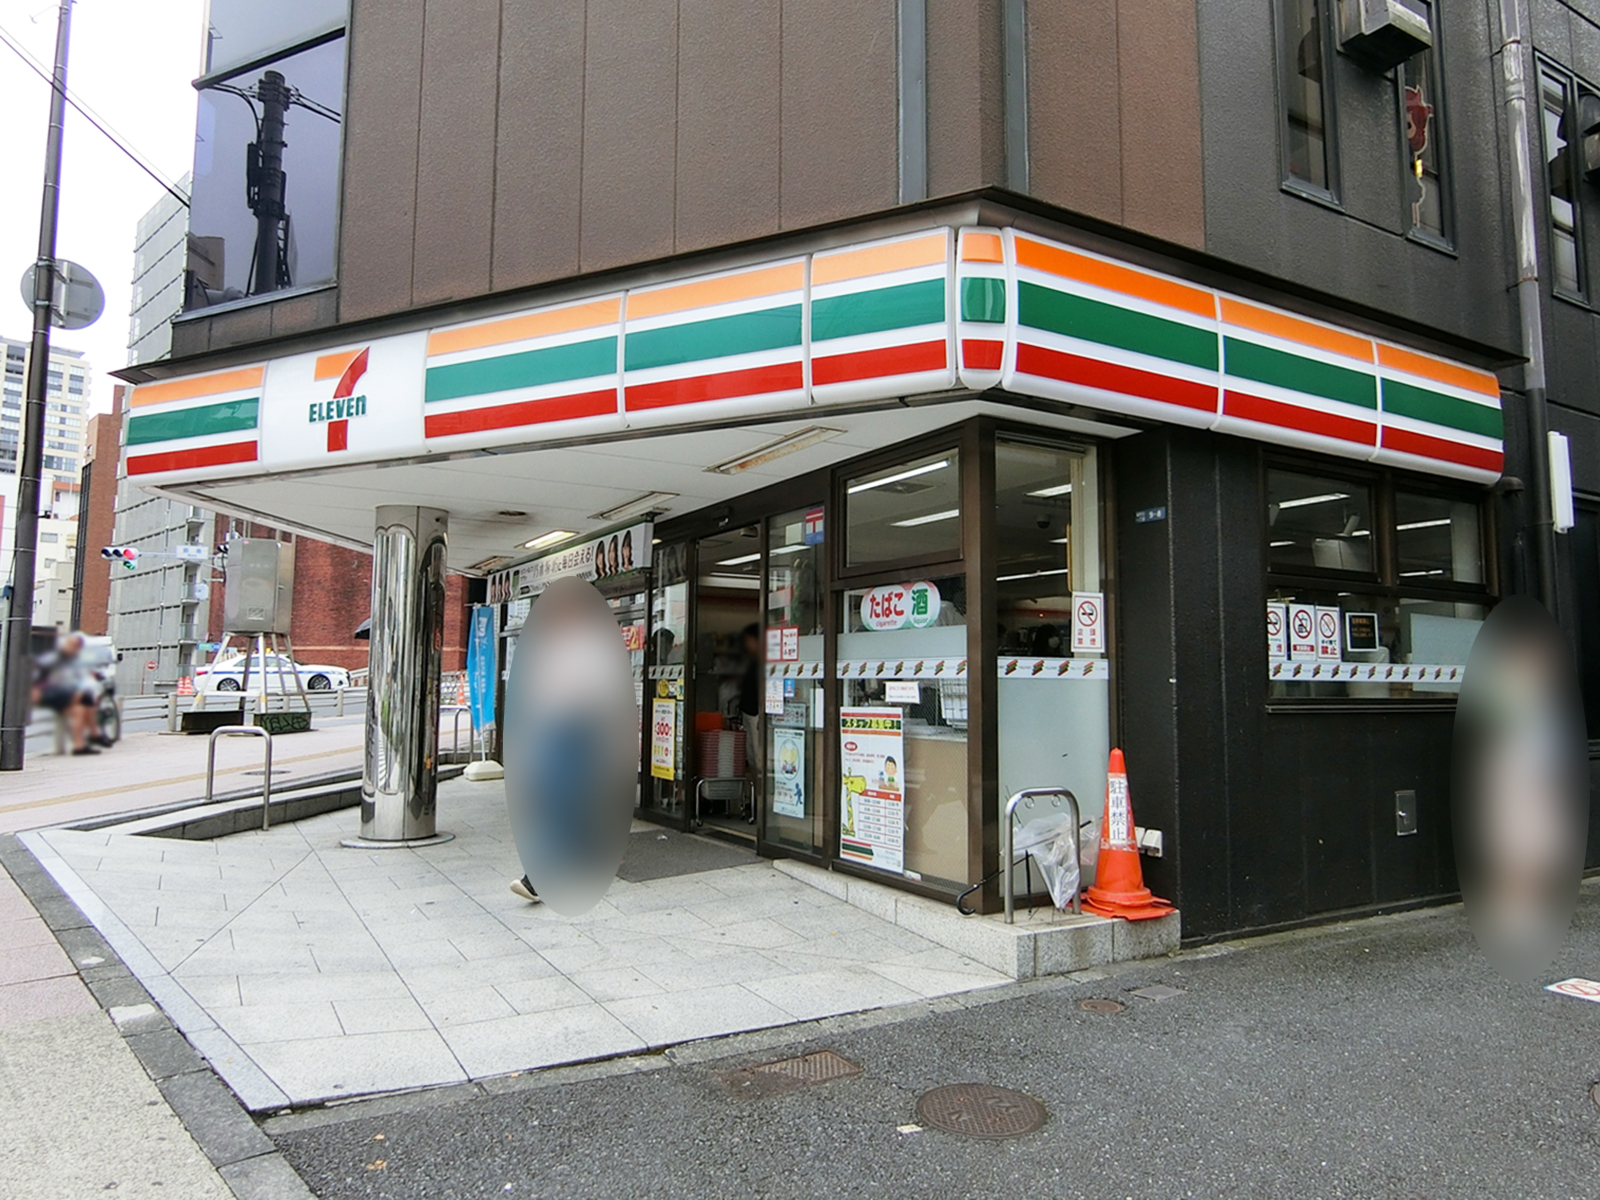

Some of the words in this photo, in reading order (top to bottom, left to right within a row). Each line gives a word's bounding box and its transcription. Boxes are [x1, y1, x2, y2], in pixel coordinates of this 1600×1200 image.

[314, 346, 370, 453] 7
[869, 591, 905, 619] たばこ
[911, 588, 929, 616] 酒
[1110, 779, 1126, 841] 駐車禁止
